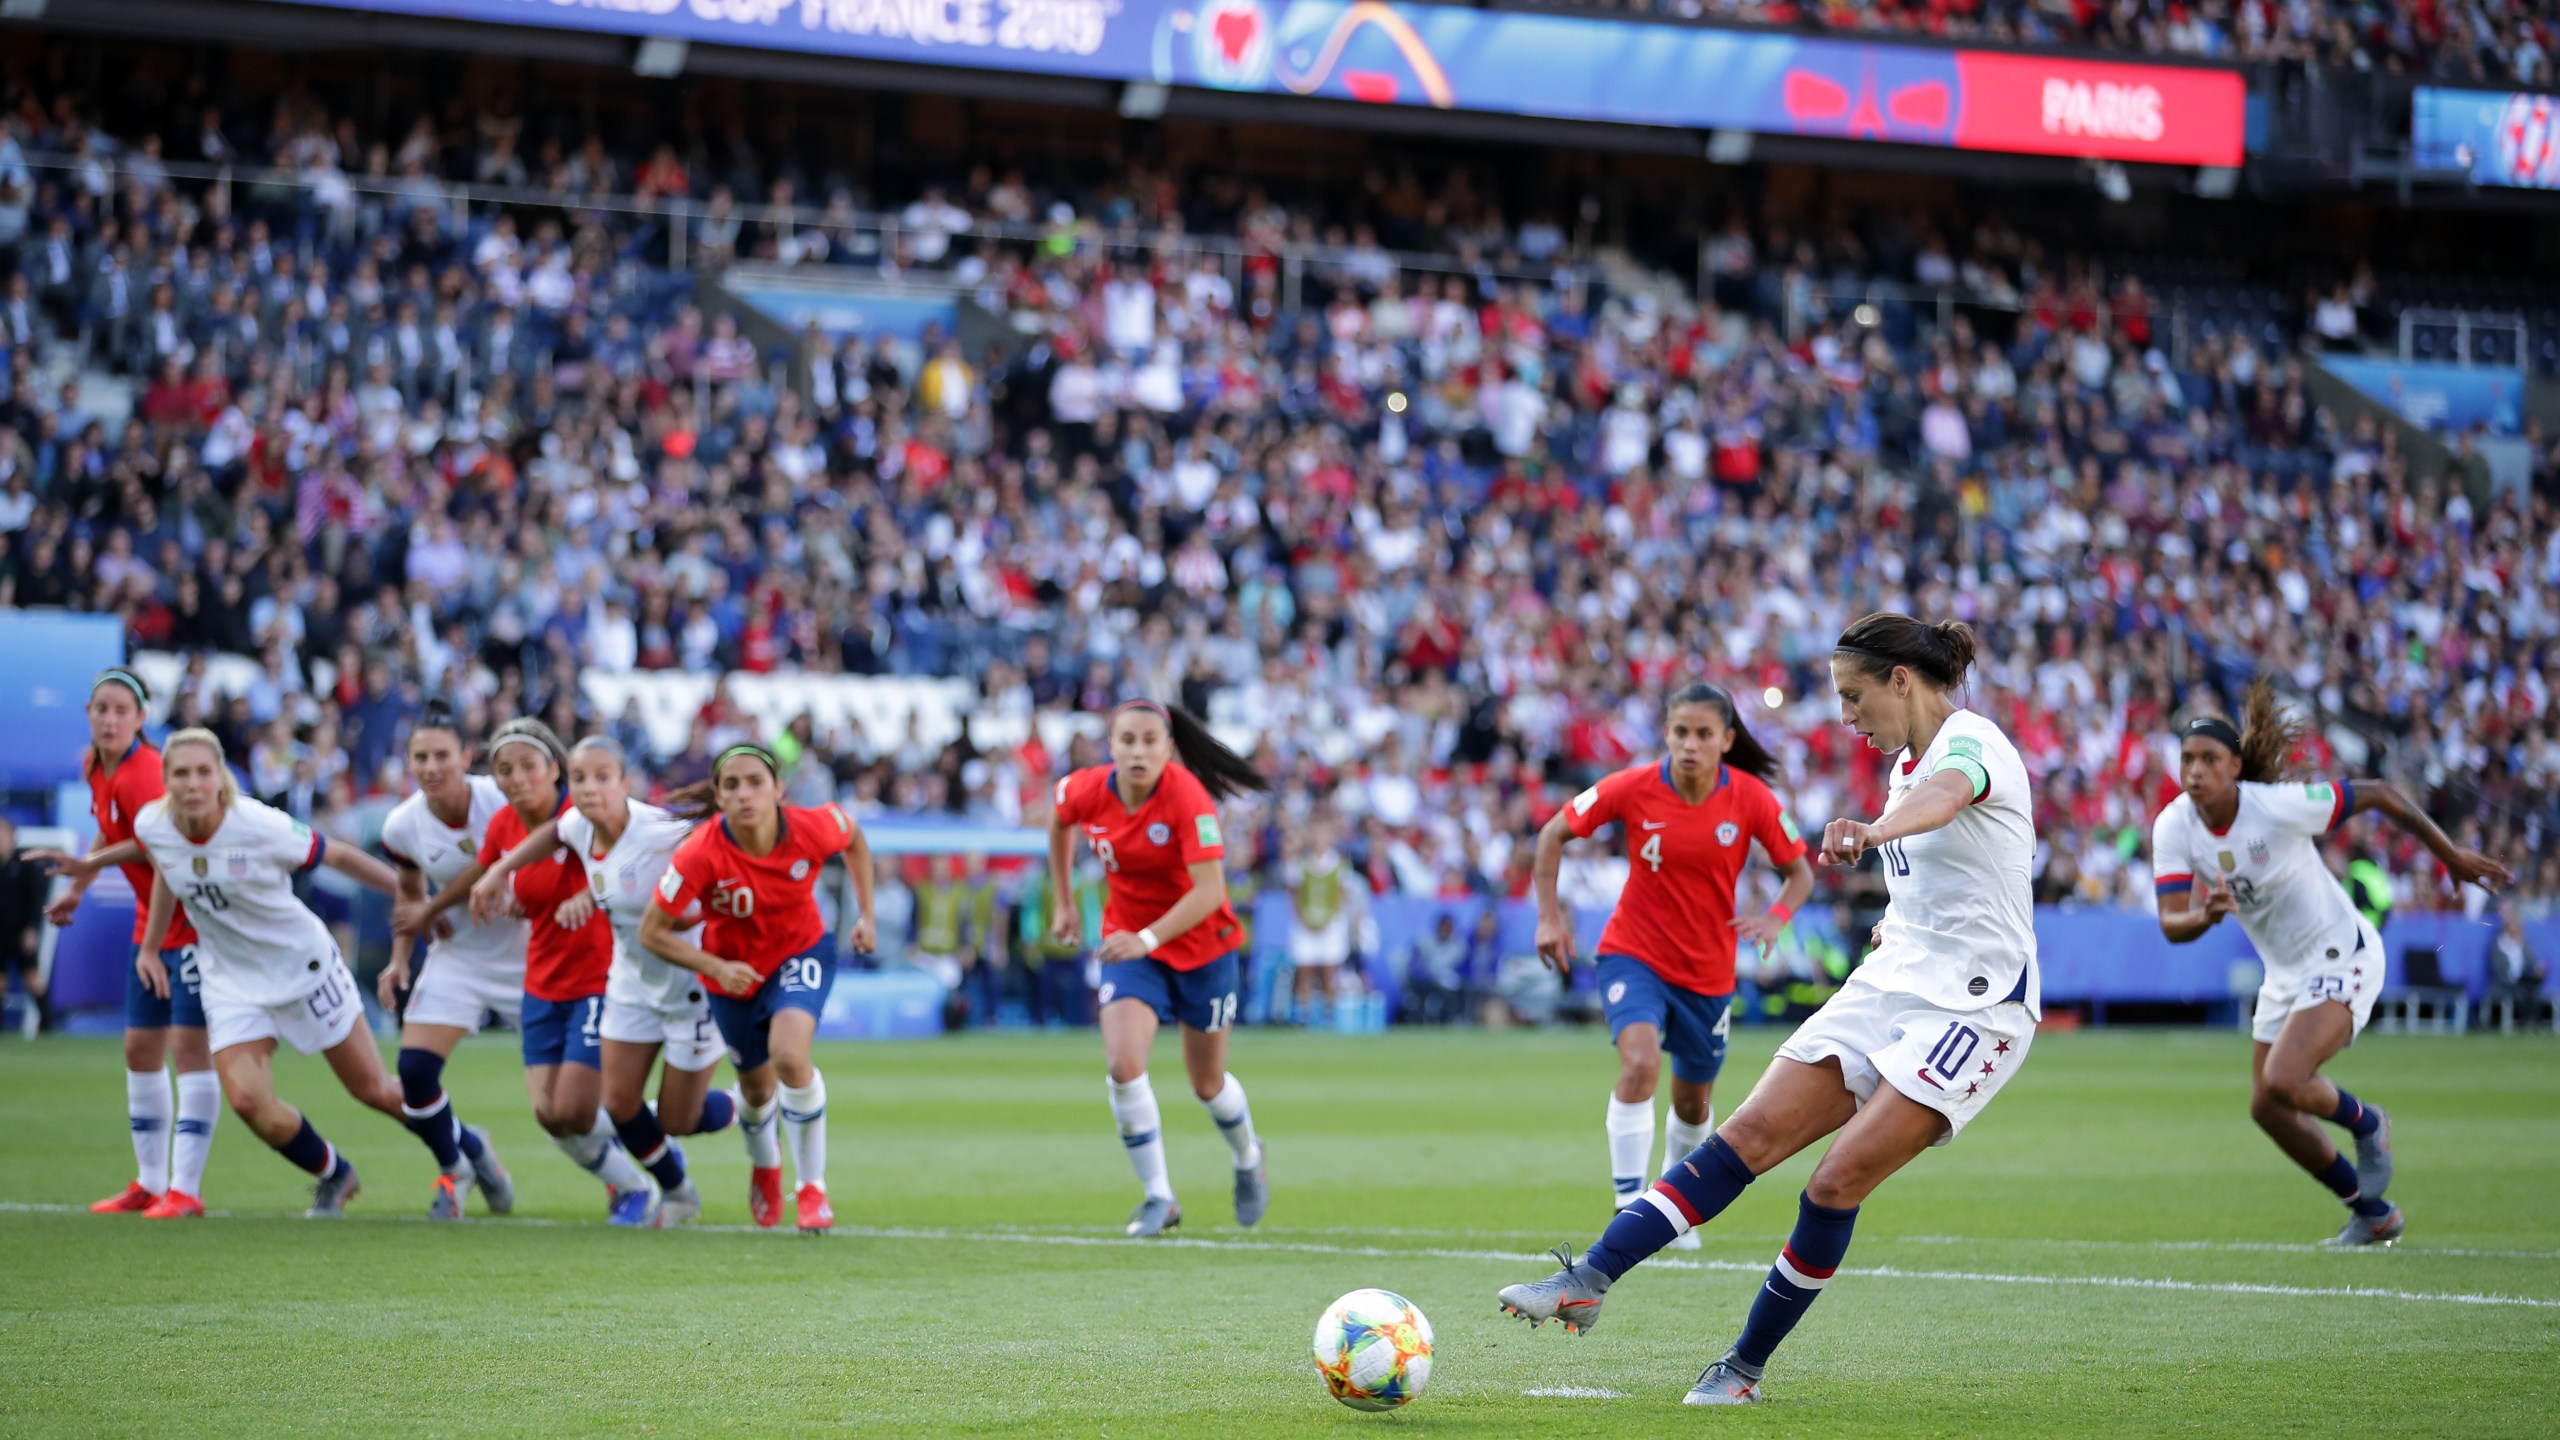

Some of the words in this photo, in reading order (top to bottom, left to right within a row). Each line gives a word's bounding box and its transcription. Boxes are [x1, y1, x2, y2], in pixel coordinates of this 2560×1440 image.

[2042, 77, 2165, 142] PARIS
[1640, 833, 1663, 873] 4
[711, 886, 754, 918] 20
[779, 957, 822, 990] 20
[1711, 1004, 1732, 1045] 4
[1925, 1020, 1980, 1081] 10
